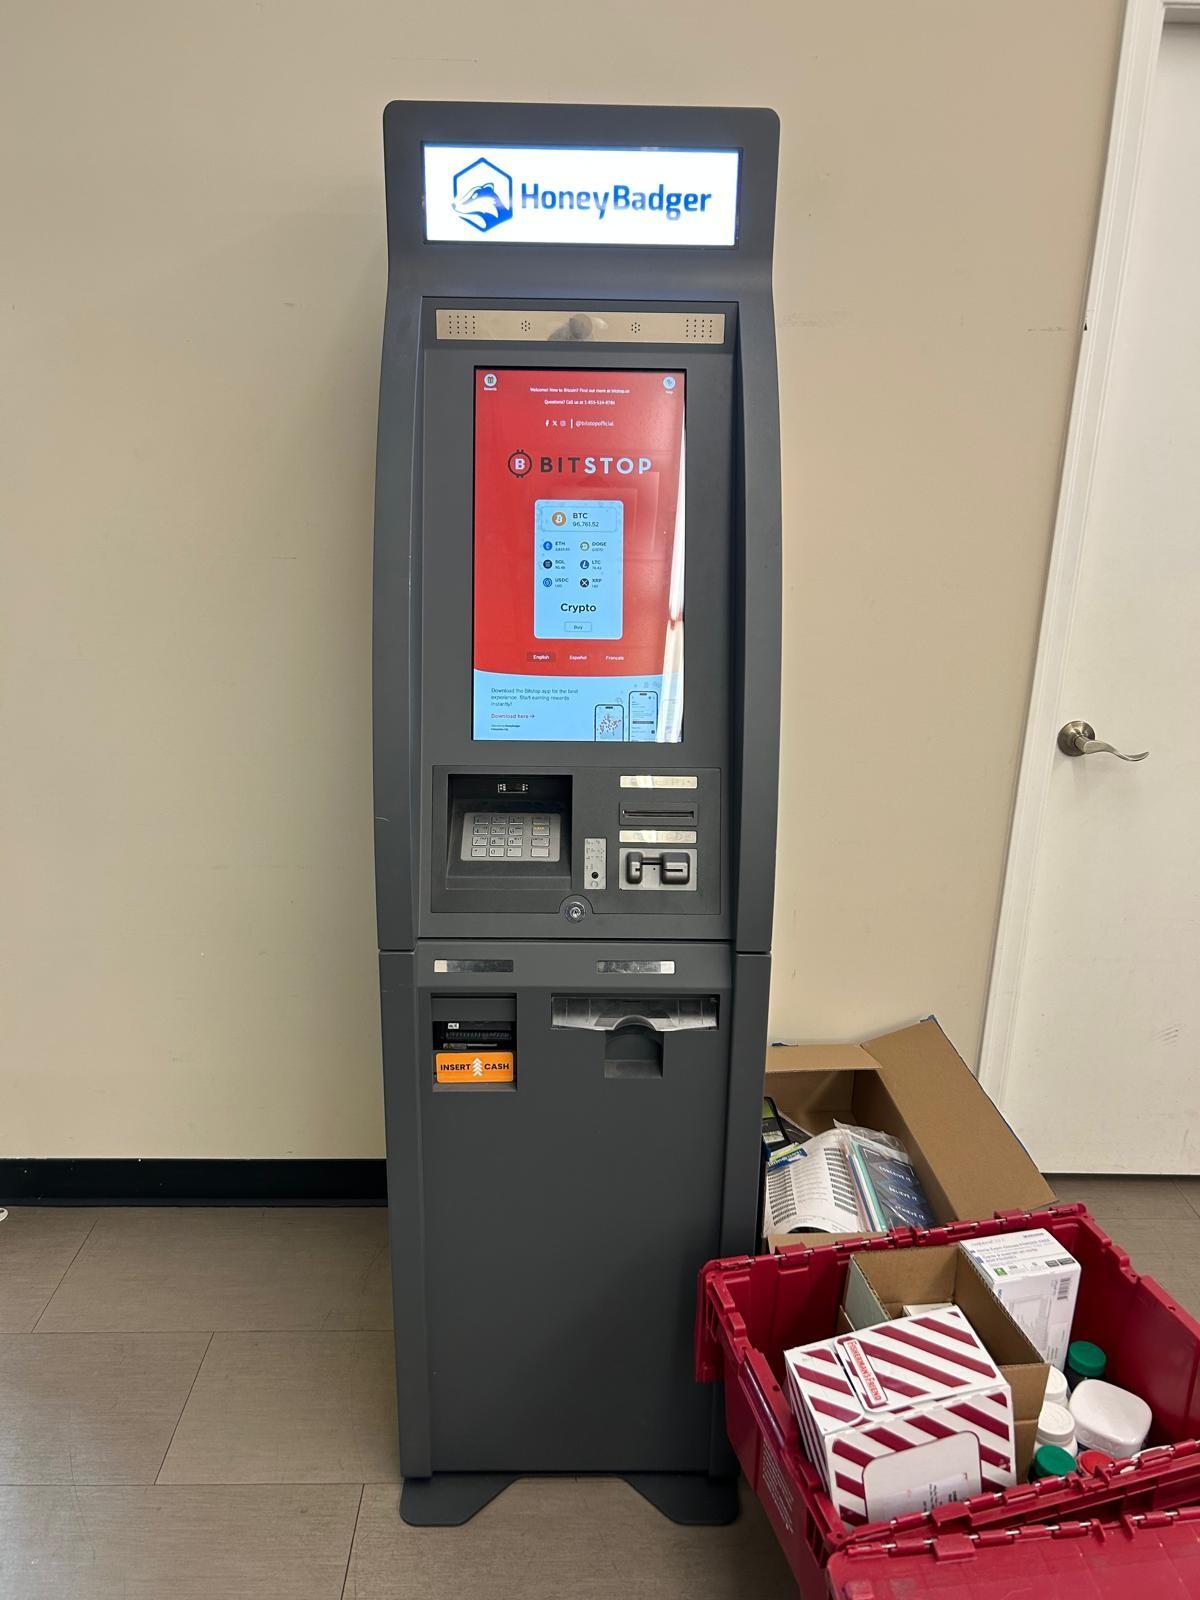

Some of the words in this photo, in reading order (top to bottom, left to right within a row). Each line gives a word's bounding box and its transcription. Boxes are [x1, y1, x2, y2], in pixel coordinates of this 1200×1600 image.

[521, 183, 712, 221] HoneyBadger
[540, 457, 652, 474] BITSTOP
[560, 603, 597, 613] Crypto
[440, 1063, 471, 1071] INSERT
